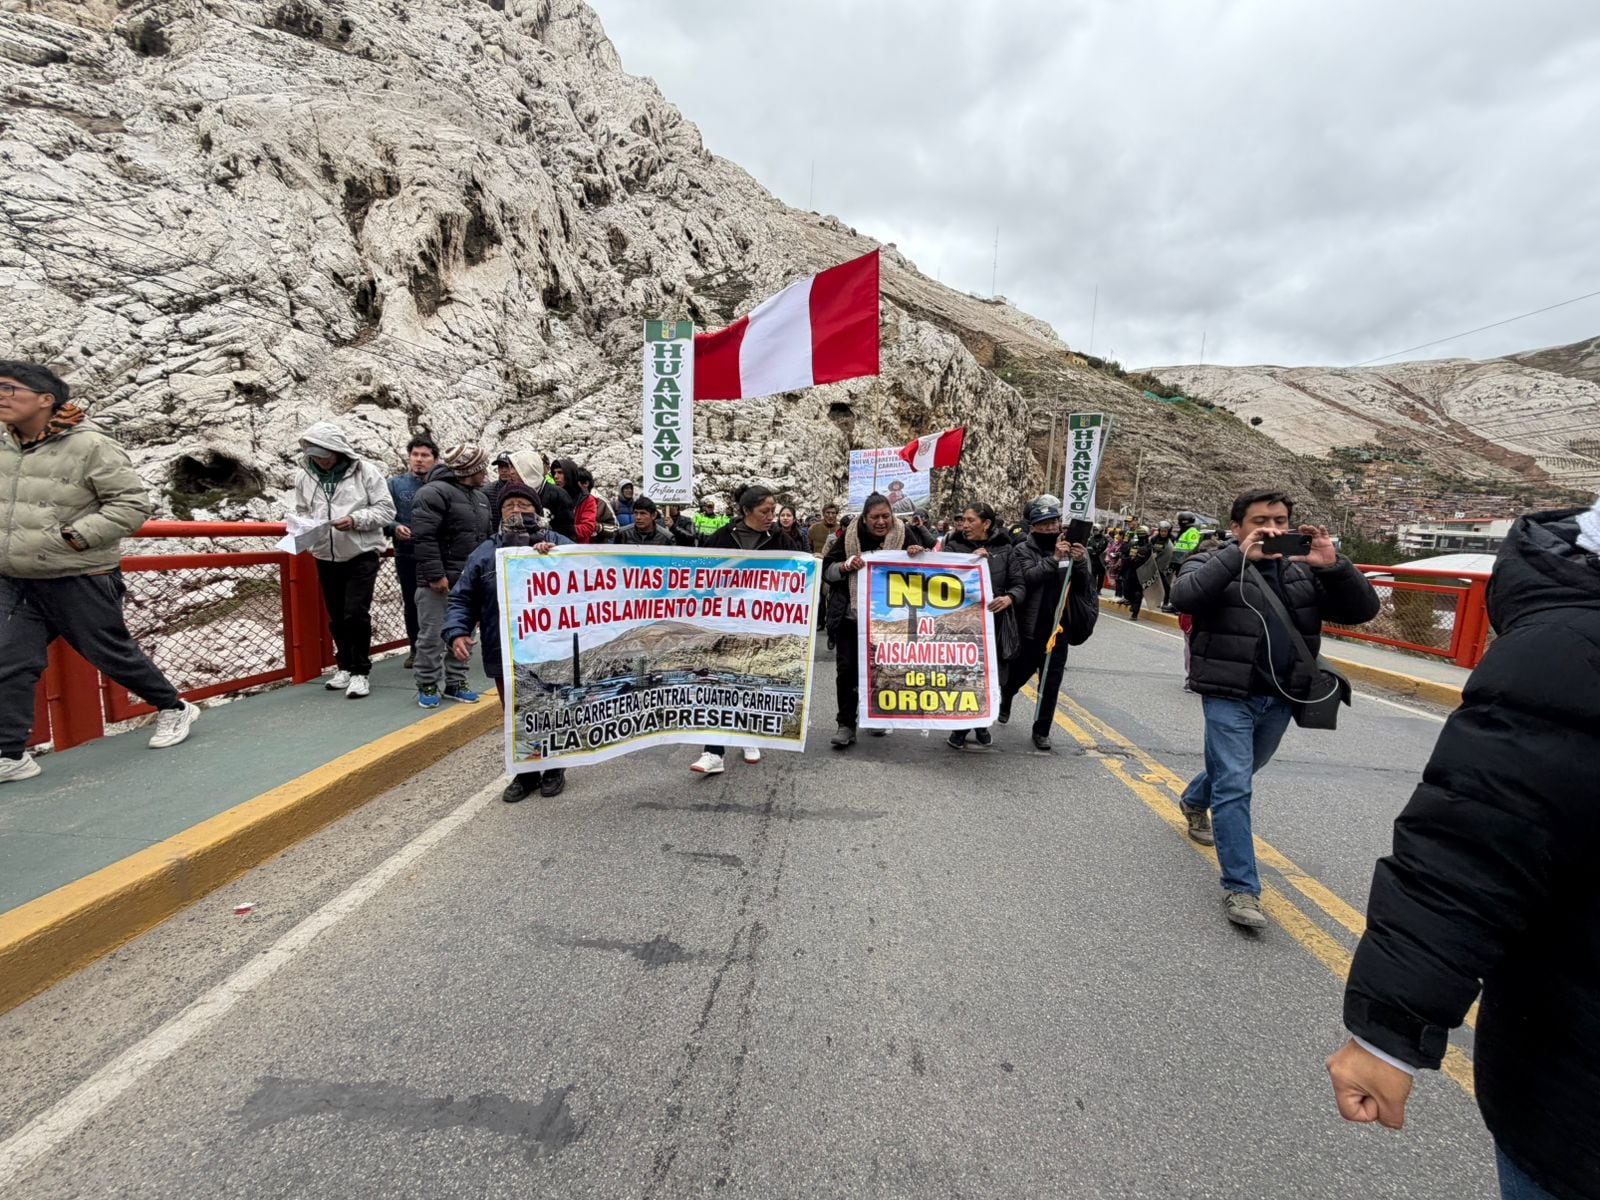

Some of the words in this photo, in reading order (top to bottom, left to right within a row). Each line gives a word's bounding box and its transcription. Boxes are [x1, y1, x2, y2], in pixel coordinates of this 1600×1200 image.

[652, 343, 684, 481] HUANCAYO
[870, 456, 902, 465] CRRETER
[1070, 430, 1095, 513] HUANCAYO
[526, 571, 561, 603] ¡NO
[567, 570, 579, 594] A
[583, 568, 617, 592] LAS
[622, 567, 663, 589] VIAS
[668, 568, 690, 589] DE
[694, 568, 806, 594] EVITAMIENTO!
[887, 572, 964, 608] NO
[517, 607, 552, 640] ¡NO
[558, 605, 581, 630] AL
[585, 598, 697, 626] AISLAMIENTO
[701, 597, 722, 617] DE
[727, 597, 747, 619] LA
[751, 600, 809, 625] OROYA!
[876, 642, 978, 665] AISLAMIENTO
[905, 671, 926, 687] de
[931, 671, 947, 687] la
[525, 712, 538, 733] SI
[542, 711, 551, 731] A
[555, 709, 571, 729] LA
[574, 691, 640, 726] CARRETERA
[643, 687, 692, 708] CENTRAL
[696, 687, 739, 707] CUATRO
[742, 691, 795, 713] CARRILES
[878, 690, 979, 711] OROYA
[542, 729, 581, 758] ¡LA
[588, 711, 658, 746] OROYA
[664, 709, 781, 733] PRESENTE!
